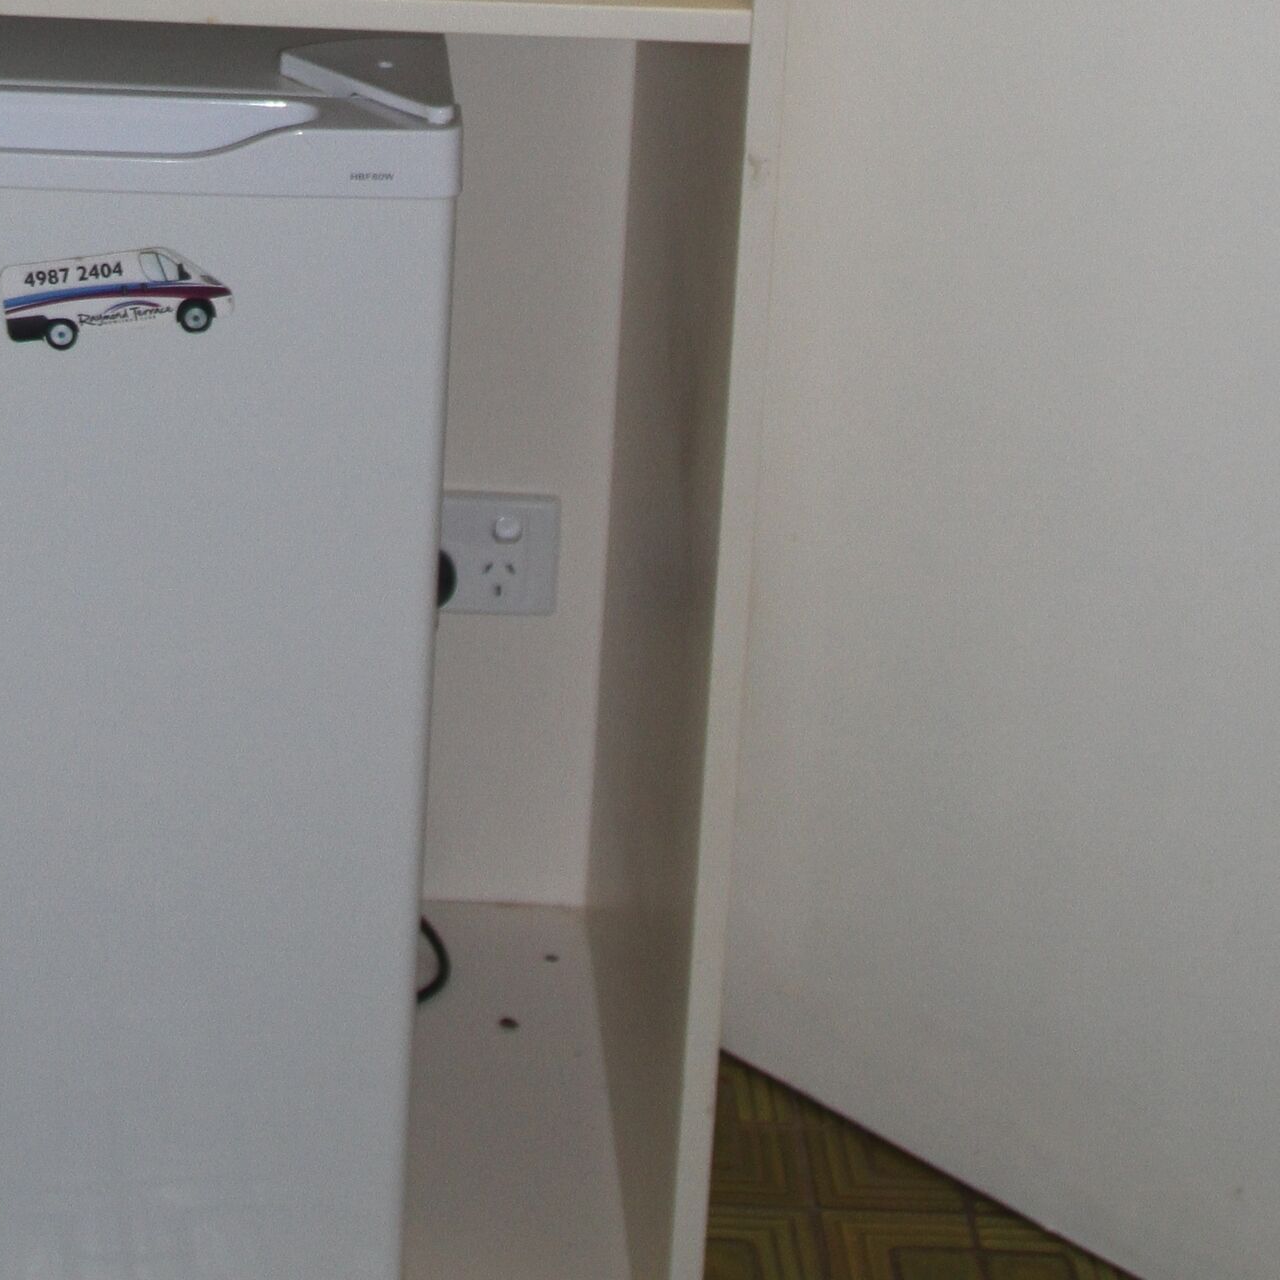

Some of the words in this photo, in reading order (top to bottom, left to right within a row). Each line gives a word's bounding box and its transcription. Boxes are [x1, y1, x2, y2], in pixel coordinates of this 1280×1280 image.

[24, 268, 70, 287] 4987
[76, 262, 124, 281] 2404
[77, 309, 129, 326] Raymond
[129, 306, 174, 321] Terrace
